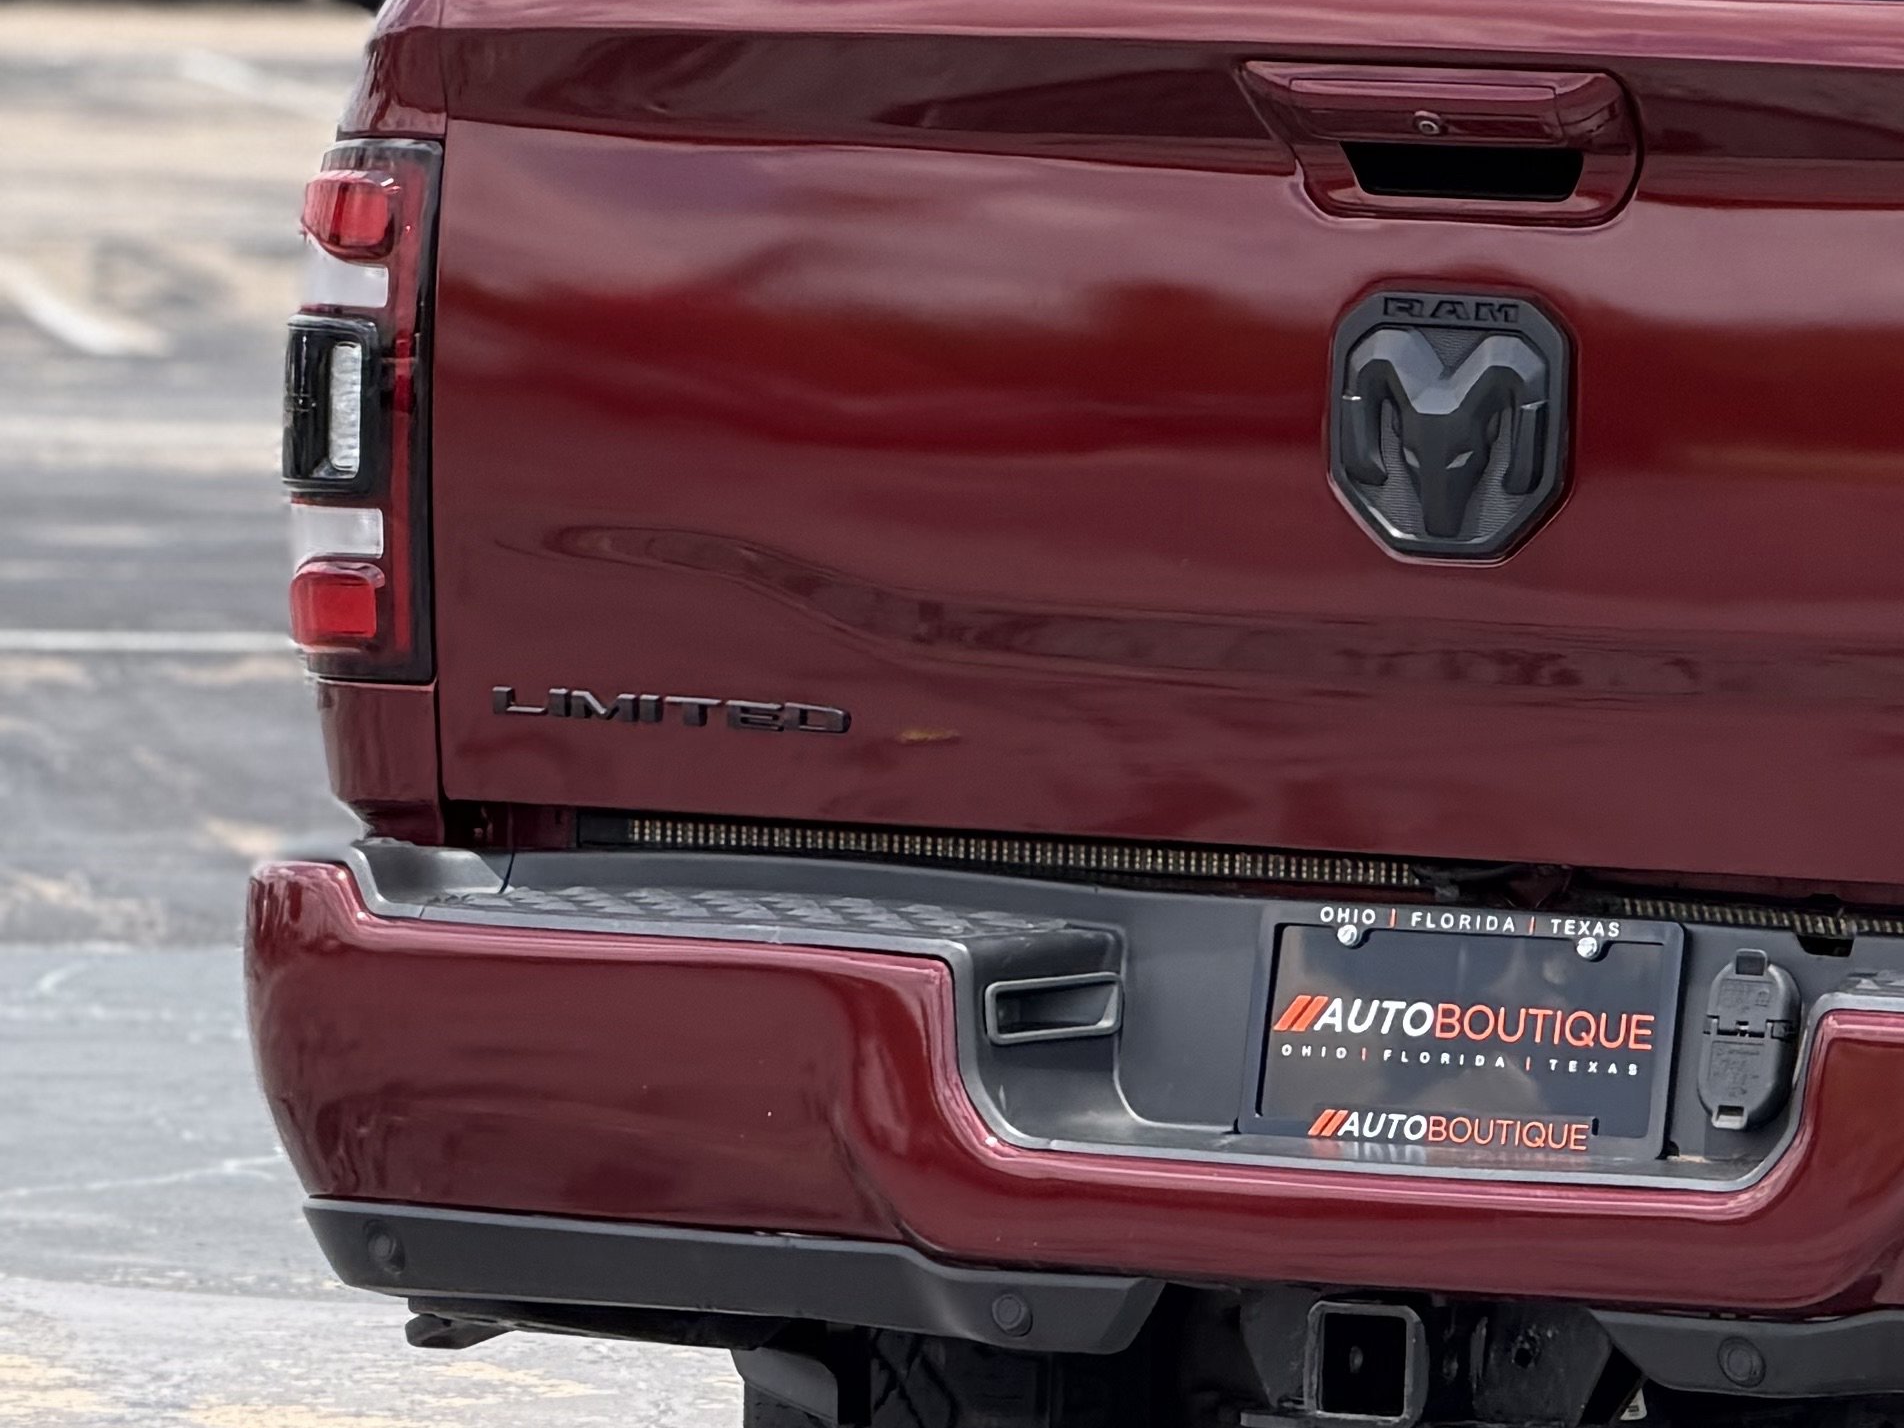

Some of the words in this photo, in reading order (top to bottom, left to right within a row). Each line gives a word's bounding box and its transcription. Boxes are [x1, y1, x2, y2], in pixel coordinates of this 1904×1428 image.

[1382, 295, 1520, 323] RAM
[492, 684, 852, 733] LIMITED
[1320, 906, 1376, 925] OHIO
[1411, 911, 1516, 933] FLORIDA
[1550, 918, 1621, 938] TEXAS
[1312, 996, 1656, 1051] AUTOBOUTIQUE
[1281, 1043, 1348, 1060] OHIO
[1383, 1048, 1505, 1069] FLORIDA
[1549, 1058, 1639, 1076] TEXAS
[1337, 1110, 1590, 1151] AUTOBOUTIQUE
